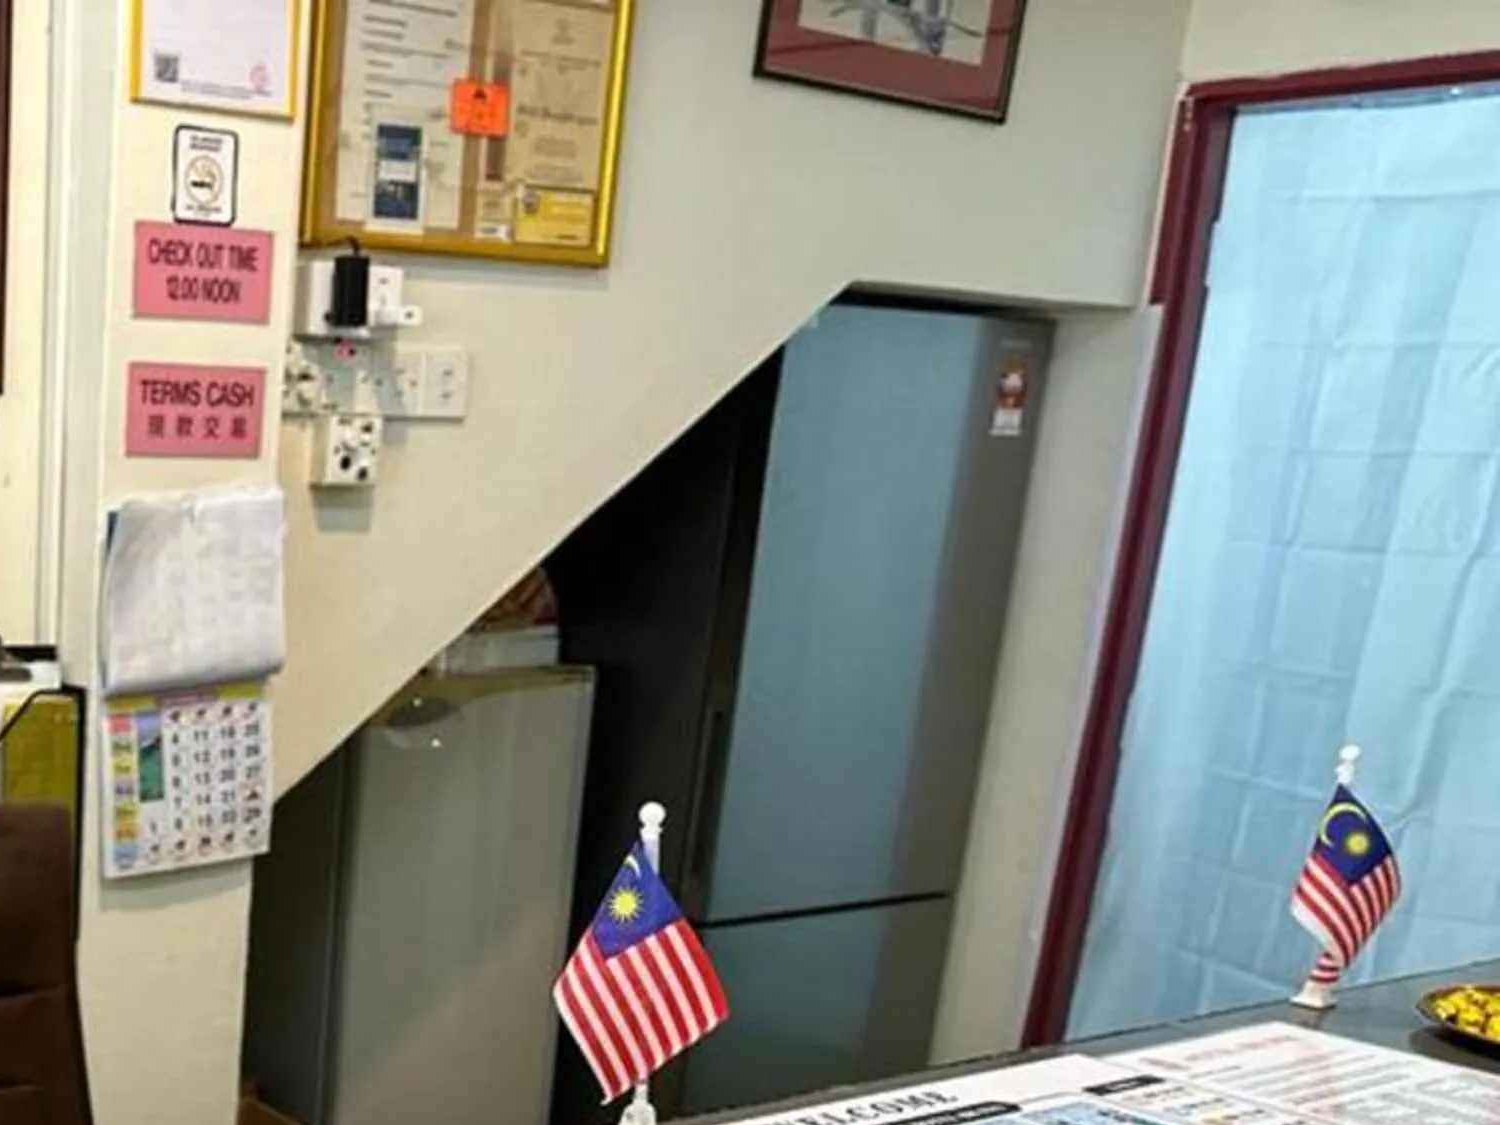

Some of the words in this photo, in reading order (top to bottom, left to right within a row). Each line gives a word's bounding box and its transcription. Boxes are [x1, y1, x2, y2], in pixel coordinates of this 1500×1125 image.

[147, 236, 194, 267] CHECK
[196, 240, 225, 270] OUT
[228, 243, 260, 273] TIME
[200, 276, 242, 304] NOON
[140, 378, 201, 408] TERMS
[205, 380, 256, 409] CASH
